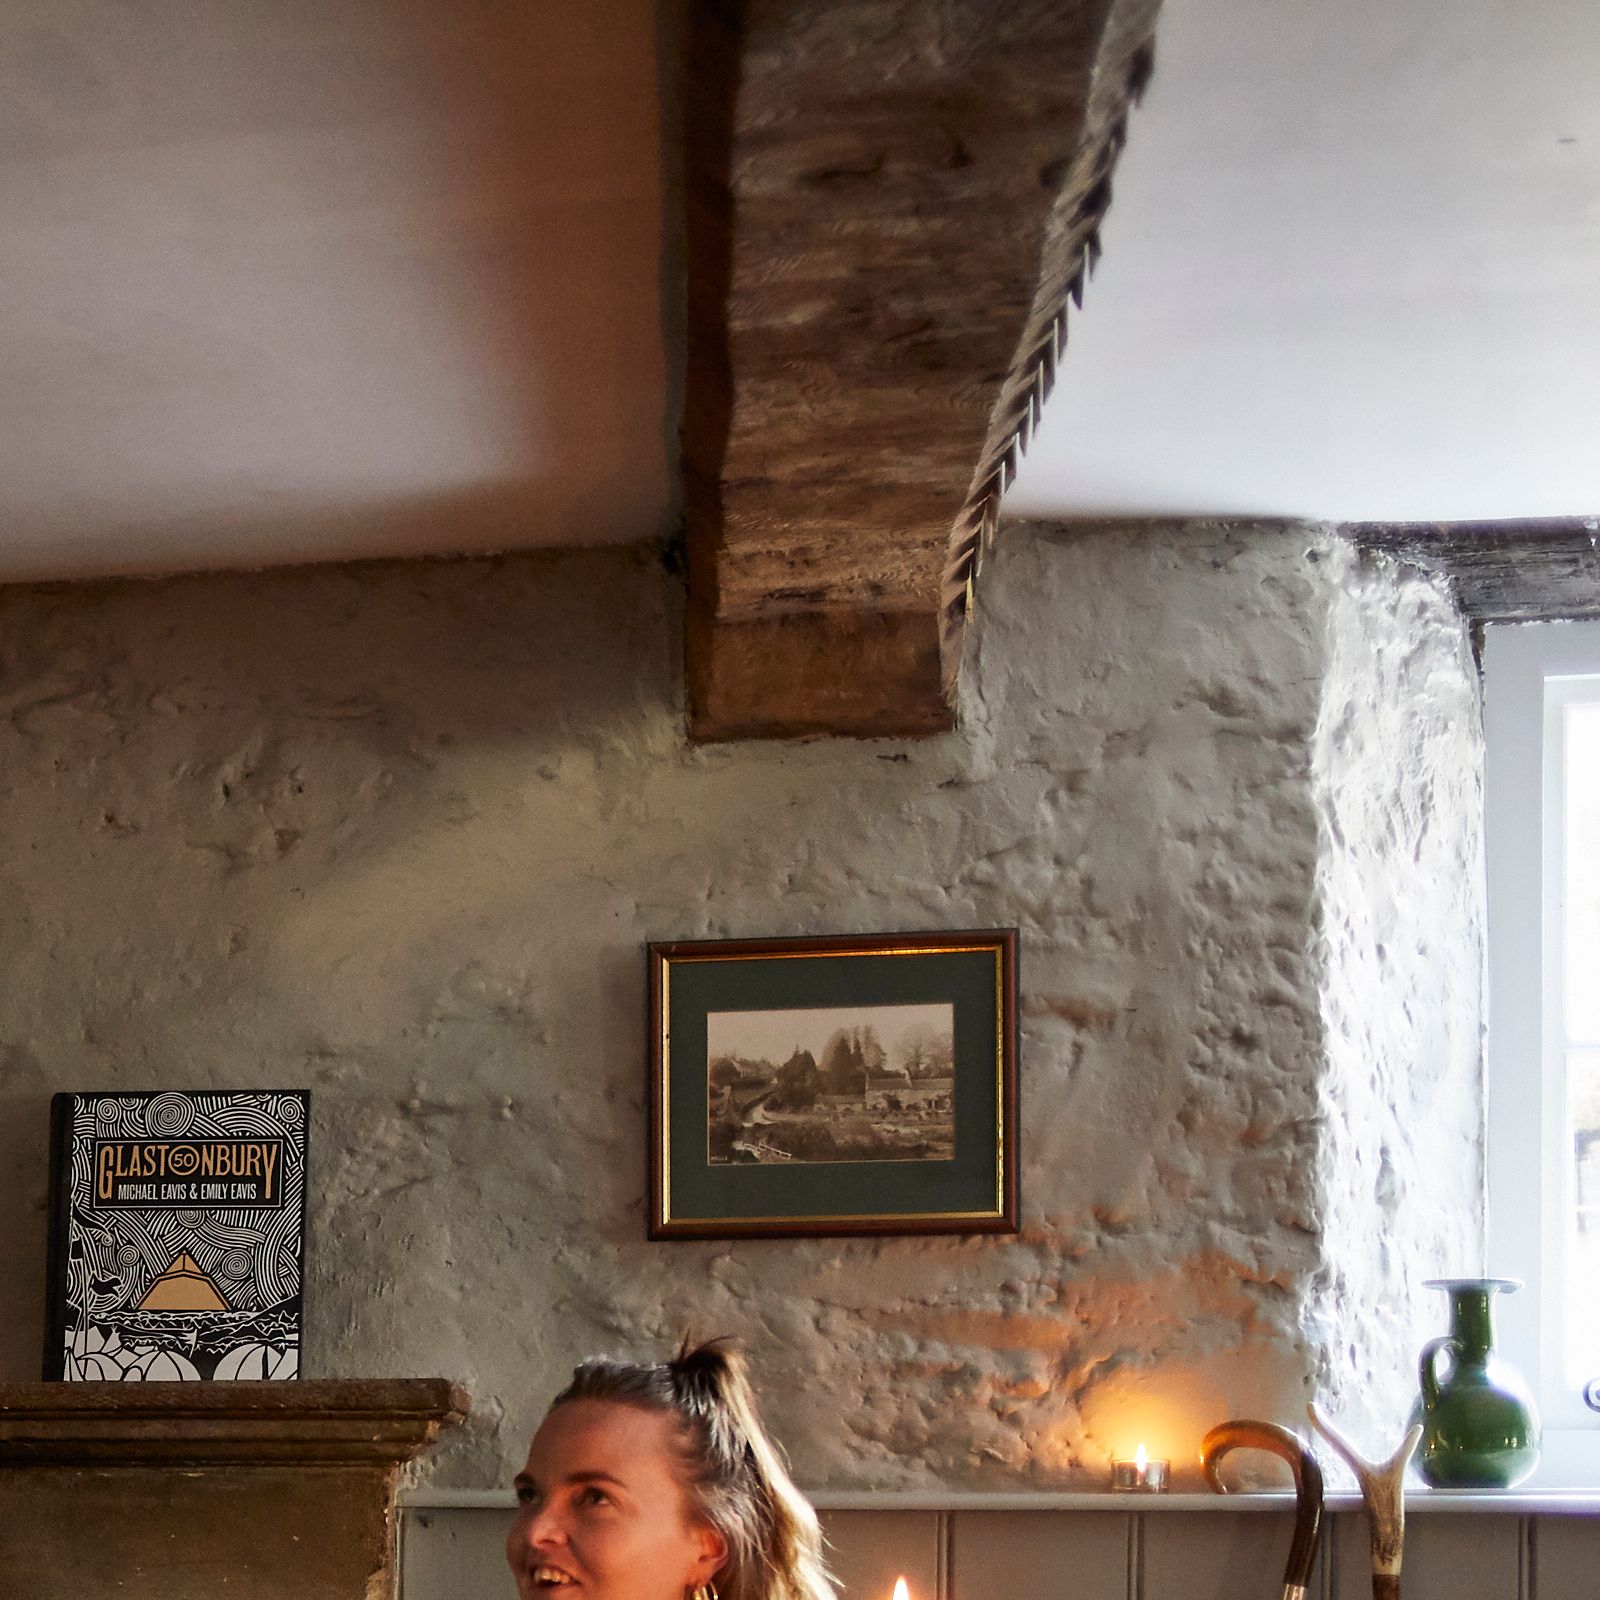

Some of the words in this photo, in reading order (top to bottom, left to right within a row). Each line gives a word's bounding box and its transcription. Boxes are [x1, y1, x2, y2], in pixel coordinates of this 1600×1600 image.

[173, 1154, 195, 1168] 50
[98, 1144, 278, 1199] GLASTONBURY
[117, 1184, 159, 1201] MICHAEL
[161, 1184, 187, 1200] EAVIS
[188, 1183, 199, 1200] &
[201, 1183, 229, 1200] EMILY
[231, 1183, 257, 1200] EAVIS
